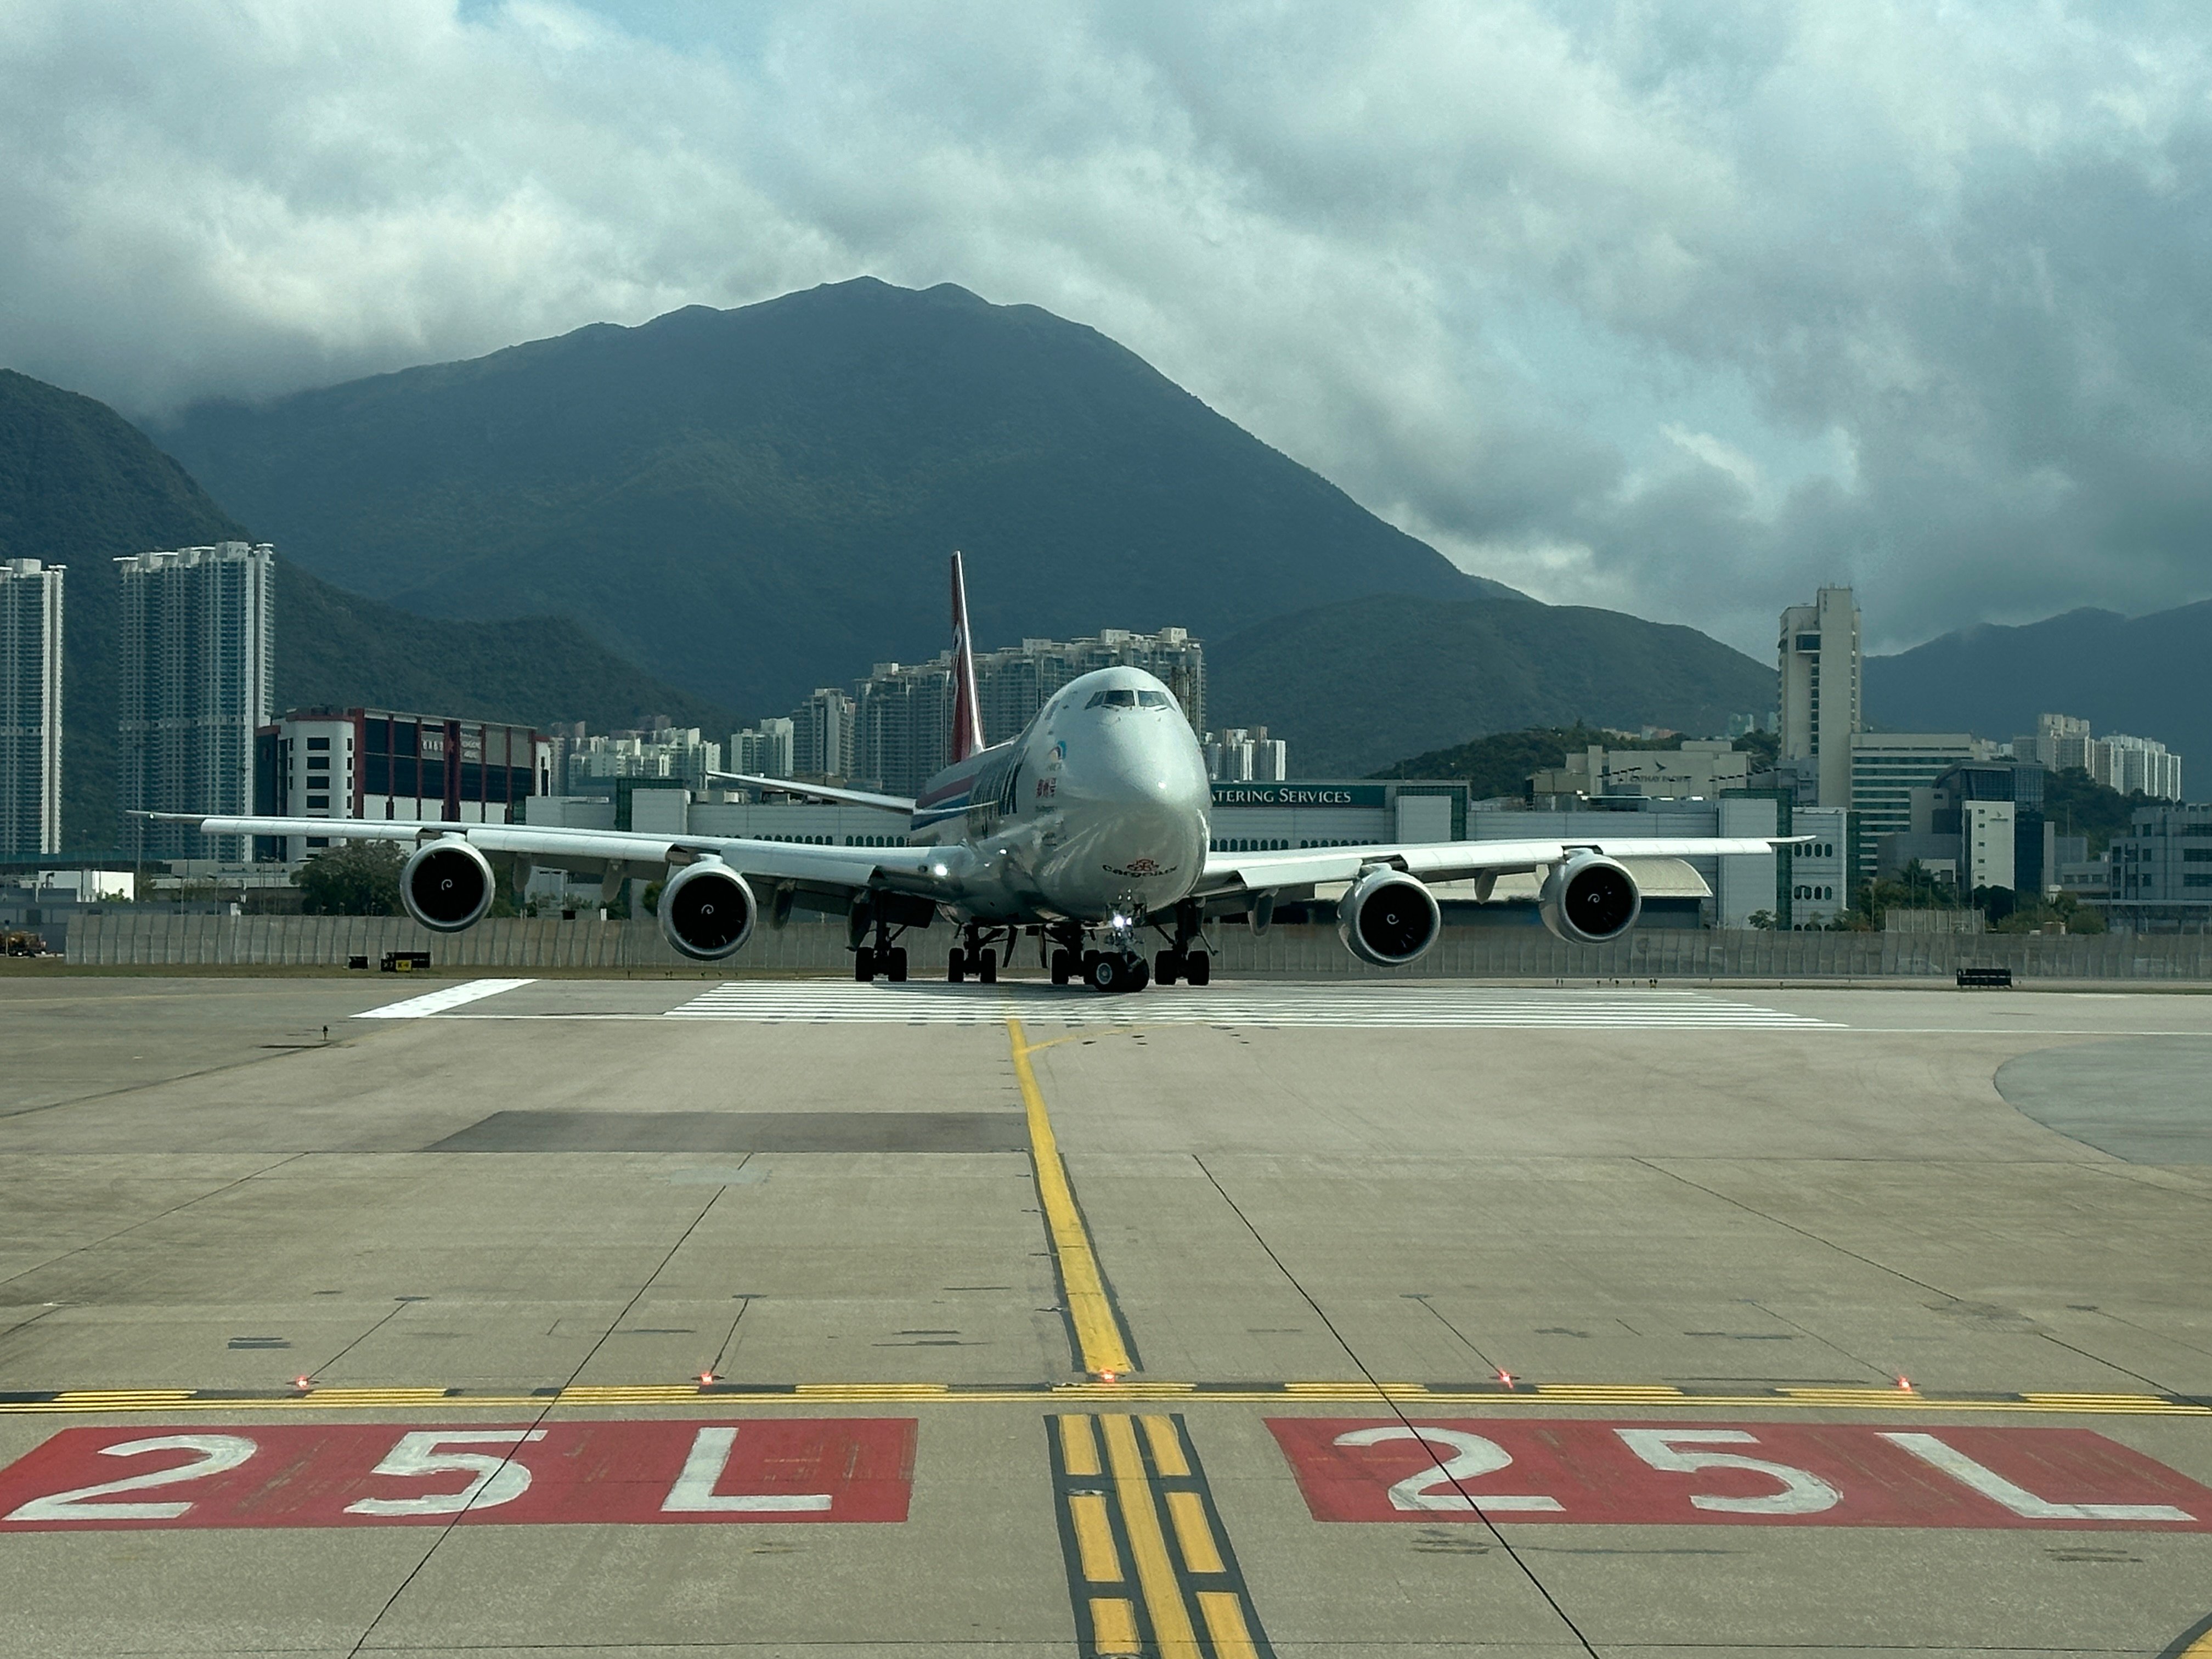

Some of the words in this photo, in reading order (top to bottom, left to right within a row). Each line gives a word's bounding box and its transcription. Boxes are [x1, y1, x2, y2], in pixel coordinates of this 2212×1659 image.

[1279, 788, 1351, 803] SERVICES
[3, 1427, 834, 1522] 25L
[1333, 1427, 2198, 1522] 25L
